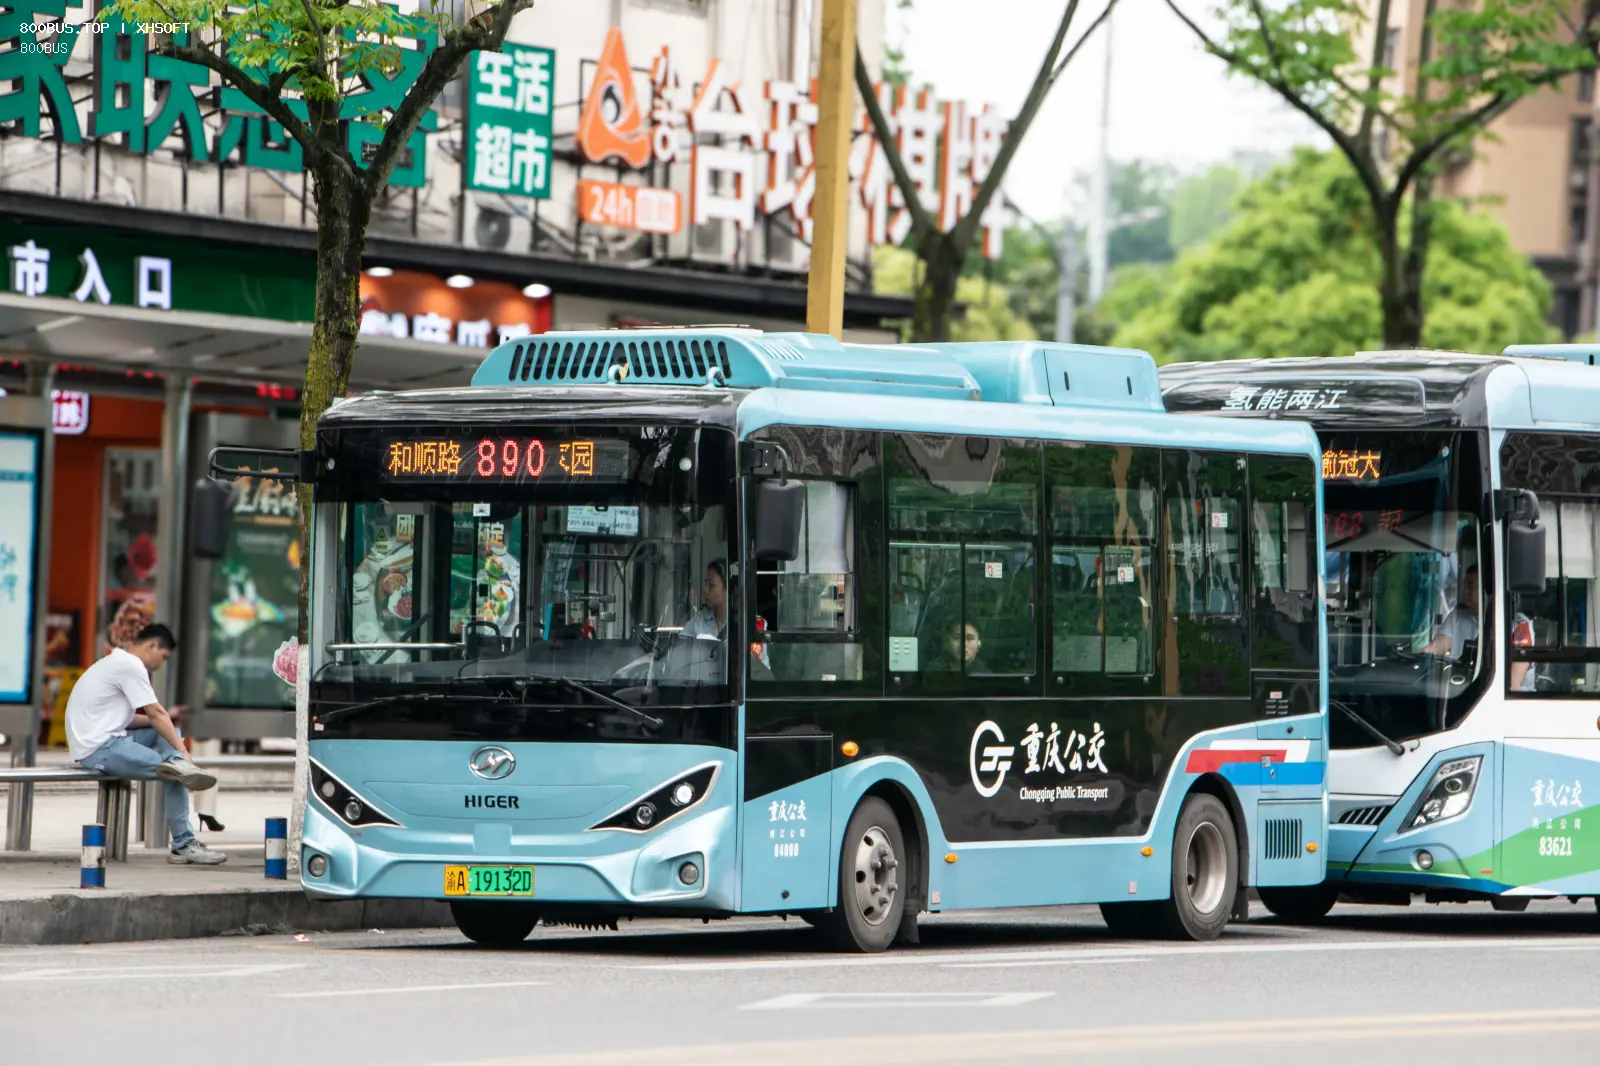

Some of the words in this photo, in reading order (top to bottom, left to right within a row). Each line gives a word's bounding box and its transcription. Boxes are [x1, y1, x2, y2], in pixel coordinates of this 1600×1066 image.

[475, 49, 550, 116] 生活
[473, 123, 549, 193] 超市
[590, 185, 634, 226] 24h
[9, 238, 172, 310] 市入口
[1220, 385, 1348, 411] 氢能两江
[388, 440, 462, 477] 和顺路
[477, 440, 545, 477] 890
[1020, 721, 1108, 775] 重庆公交
[464, 794, 520, 809] HIGER
[1019, 786, 1055, 803] Chongqing
[1055, 785, 1076, 800] Public
[1076, 785, 1109, 802] Transport
[1529, 779, 1584, 808] 重庆公交
[768, 799, 807, 823] 重庆公交
[1539, 835, 1573, 857] 83621
